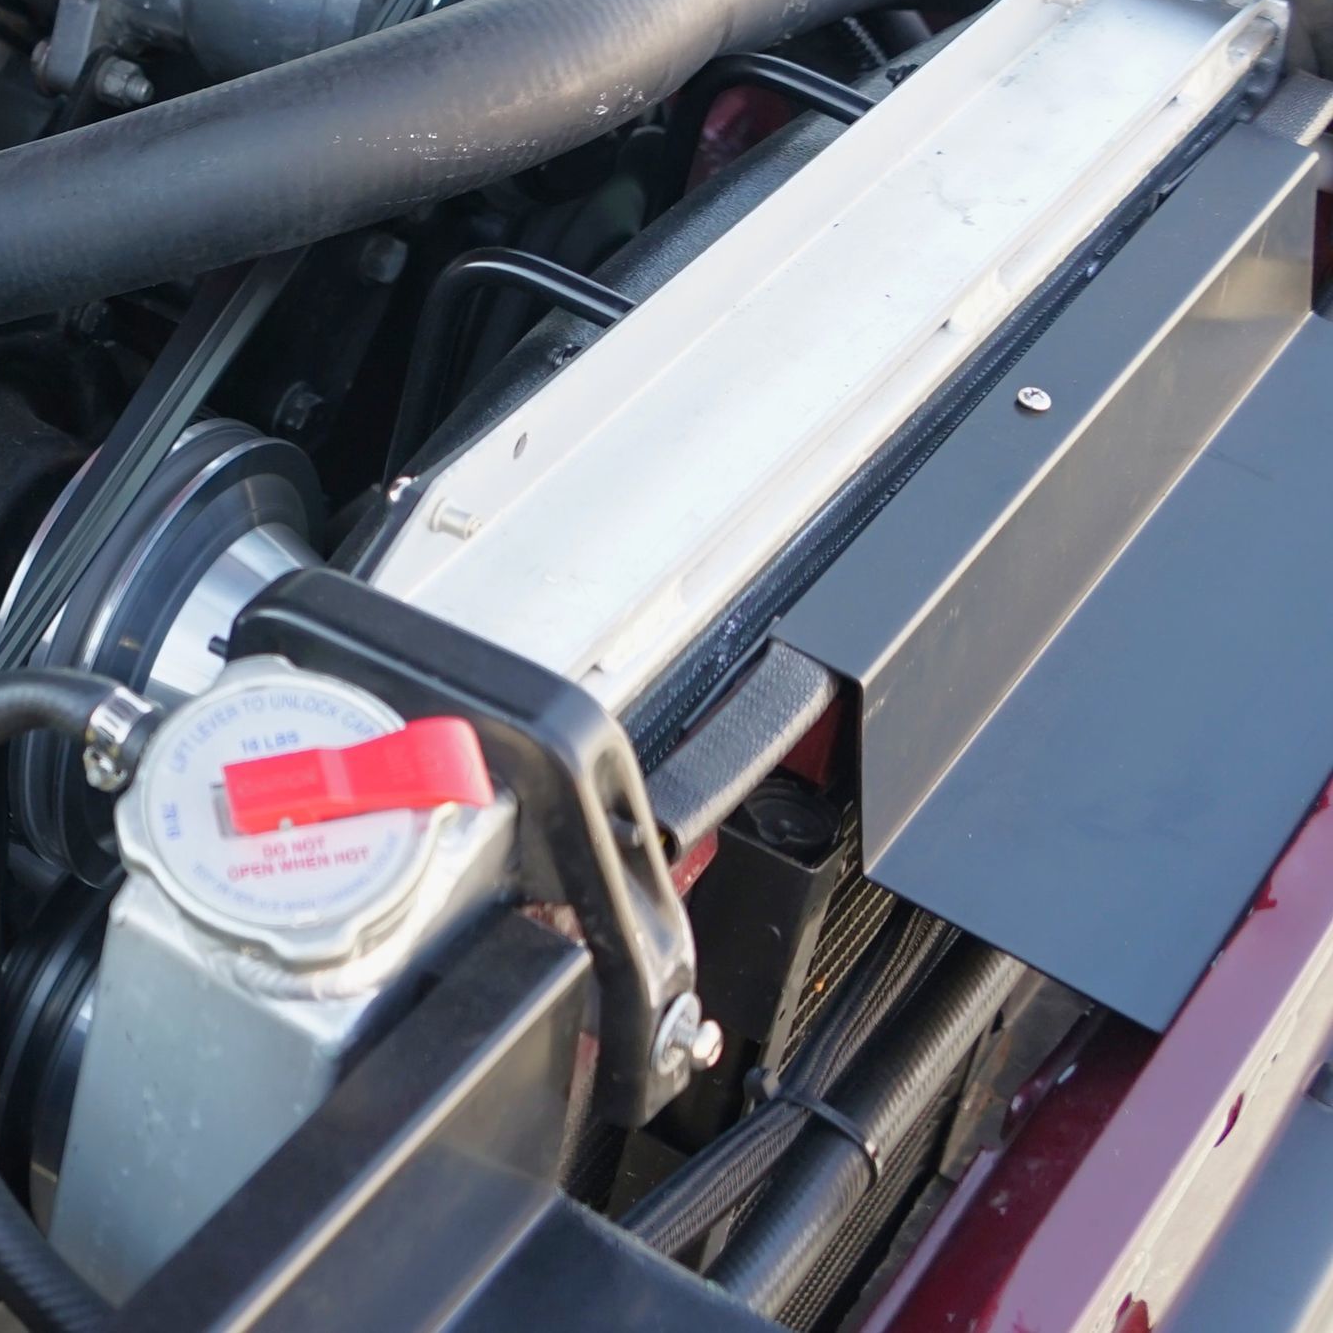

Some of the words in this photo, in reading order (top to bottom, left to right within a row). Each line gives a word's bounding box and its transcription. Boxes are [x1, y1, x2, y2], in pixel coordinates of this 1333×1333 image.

[242, 693, 264, 713] TO
[269, 693, 340, 717] UNLOCK
[262, 841, 288, 859] DO
[291, 835, 326, 855] NOT
[226, 861, 275, 882] OPEN
[278, 854, 330, 875] WHEN
[333, 845, 370, 865] HOT
